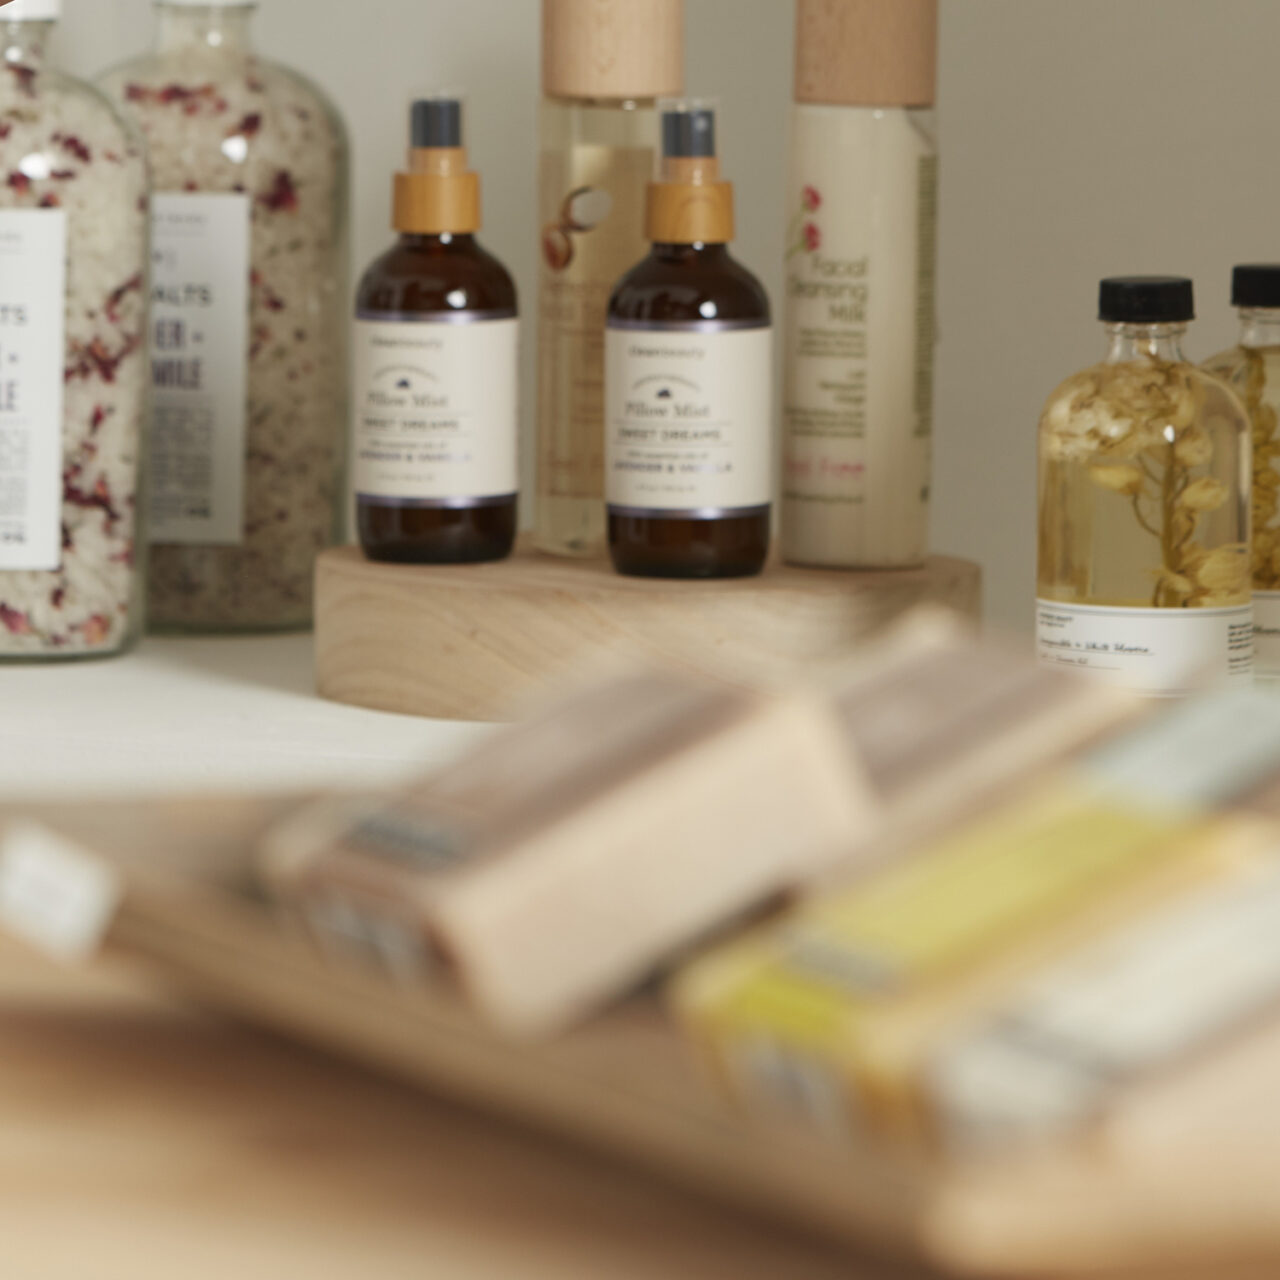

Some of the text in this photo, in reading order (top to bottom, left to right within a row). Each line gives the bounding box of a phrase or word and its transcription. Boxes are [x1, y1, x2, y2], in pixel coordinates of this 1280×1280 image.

[812, 255, 867, 278] Facial
[828, 304, 865, 323] Milk
[625, 401, 711, 418] Pillow Mist
